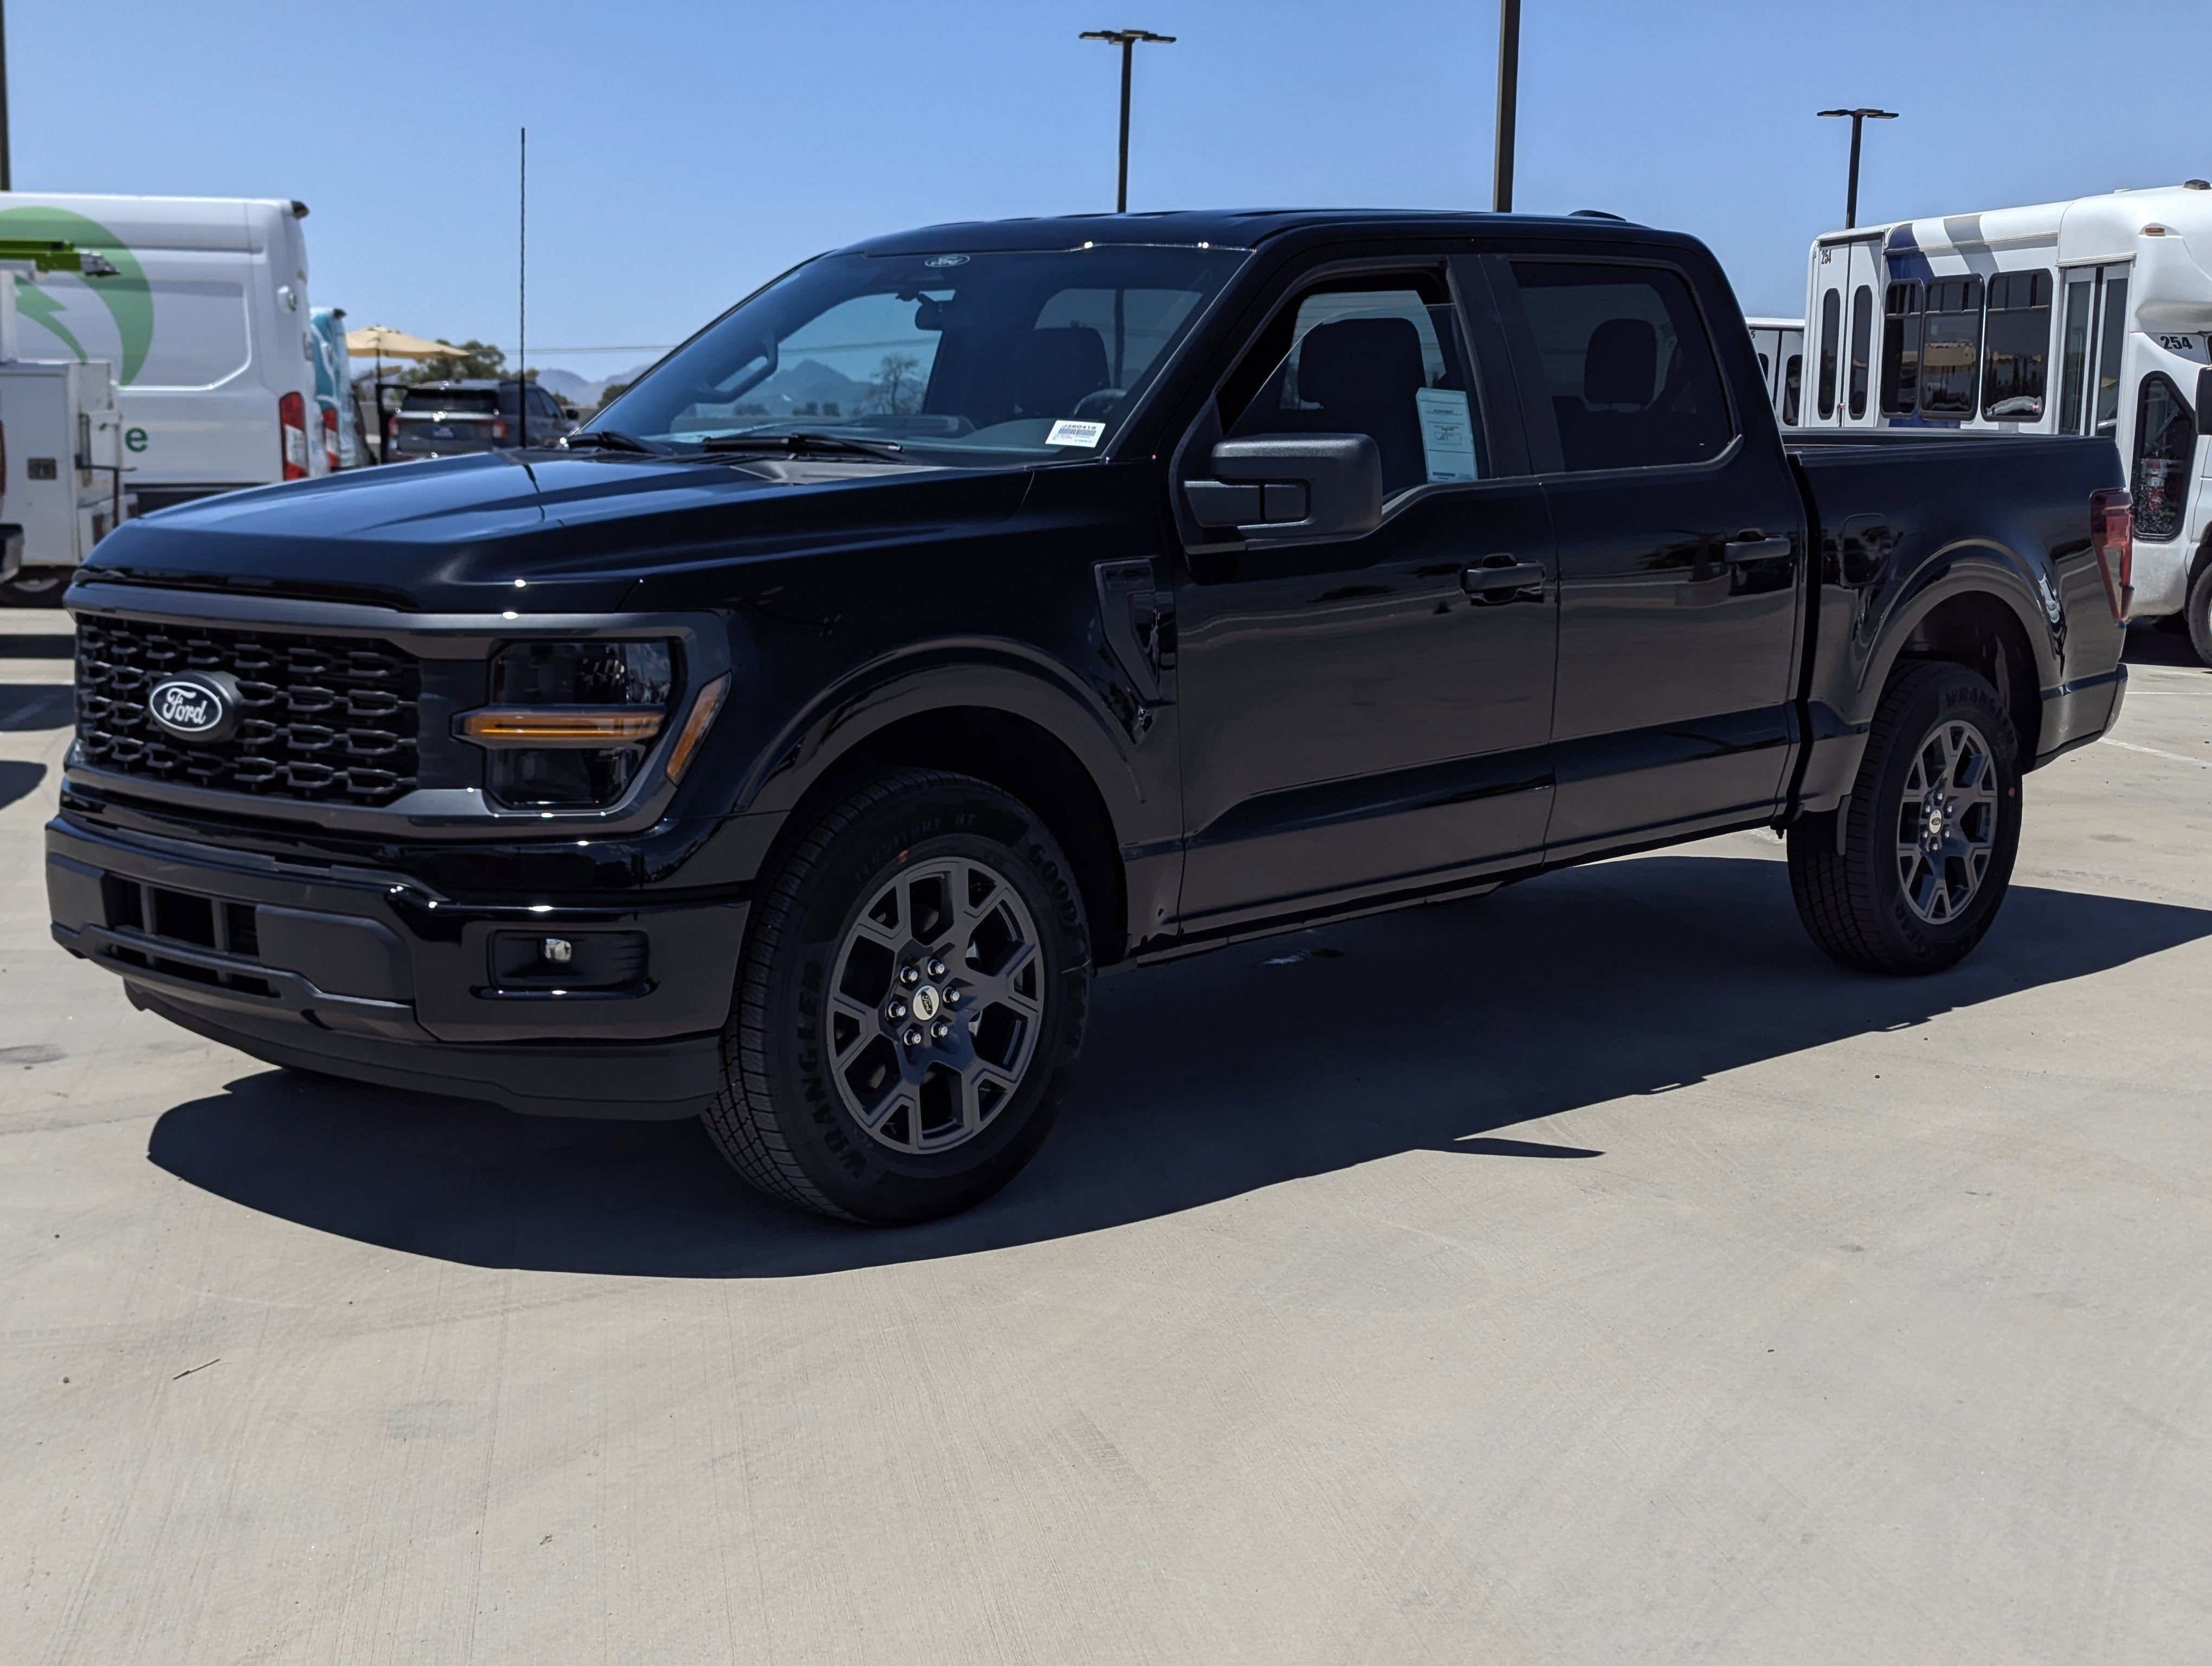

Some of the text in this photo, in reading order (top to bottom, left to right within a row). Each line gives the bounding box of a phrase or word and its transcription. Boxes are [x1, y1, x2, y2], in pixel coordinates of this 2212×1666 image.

[1821, 249, 1831, 265] 254
[2160, 336, 2192, 350] 254
[163, 687, 208, 725] Ford
[796, 961, 867, 1178] WRANGLER
